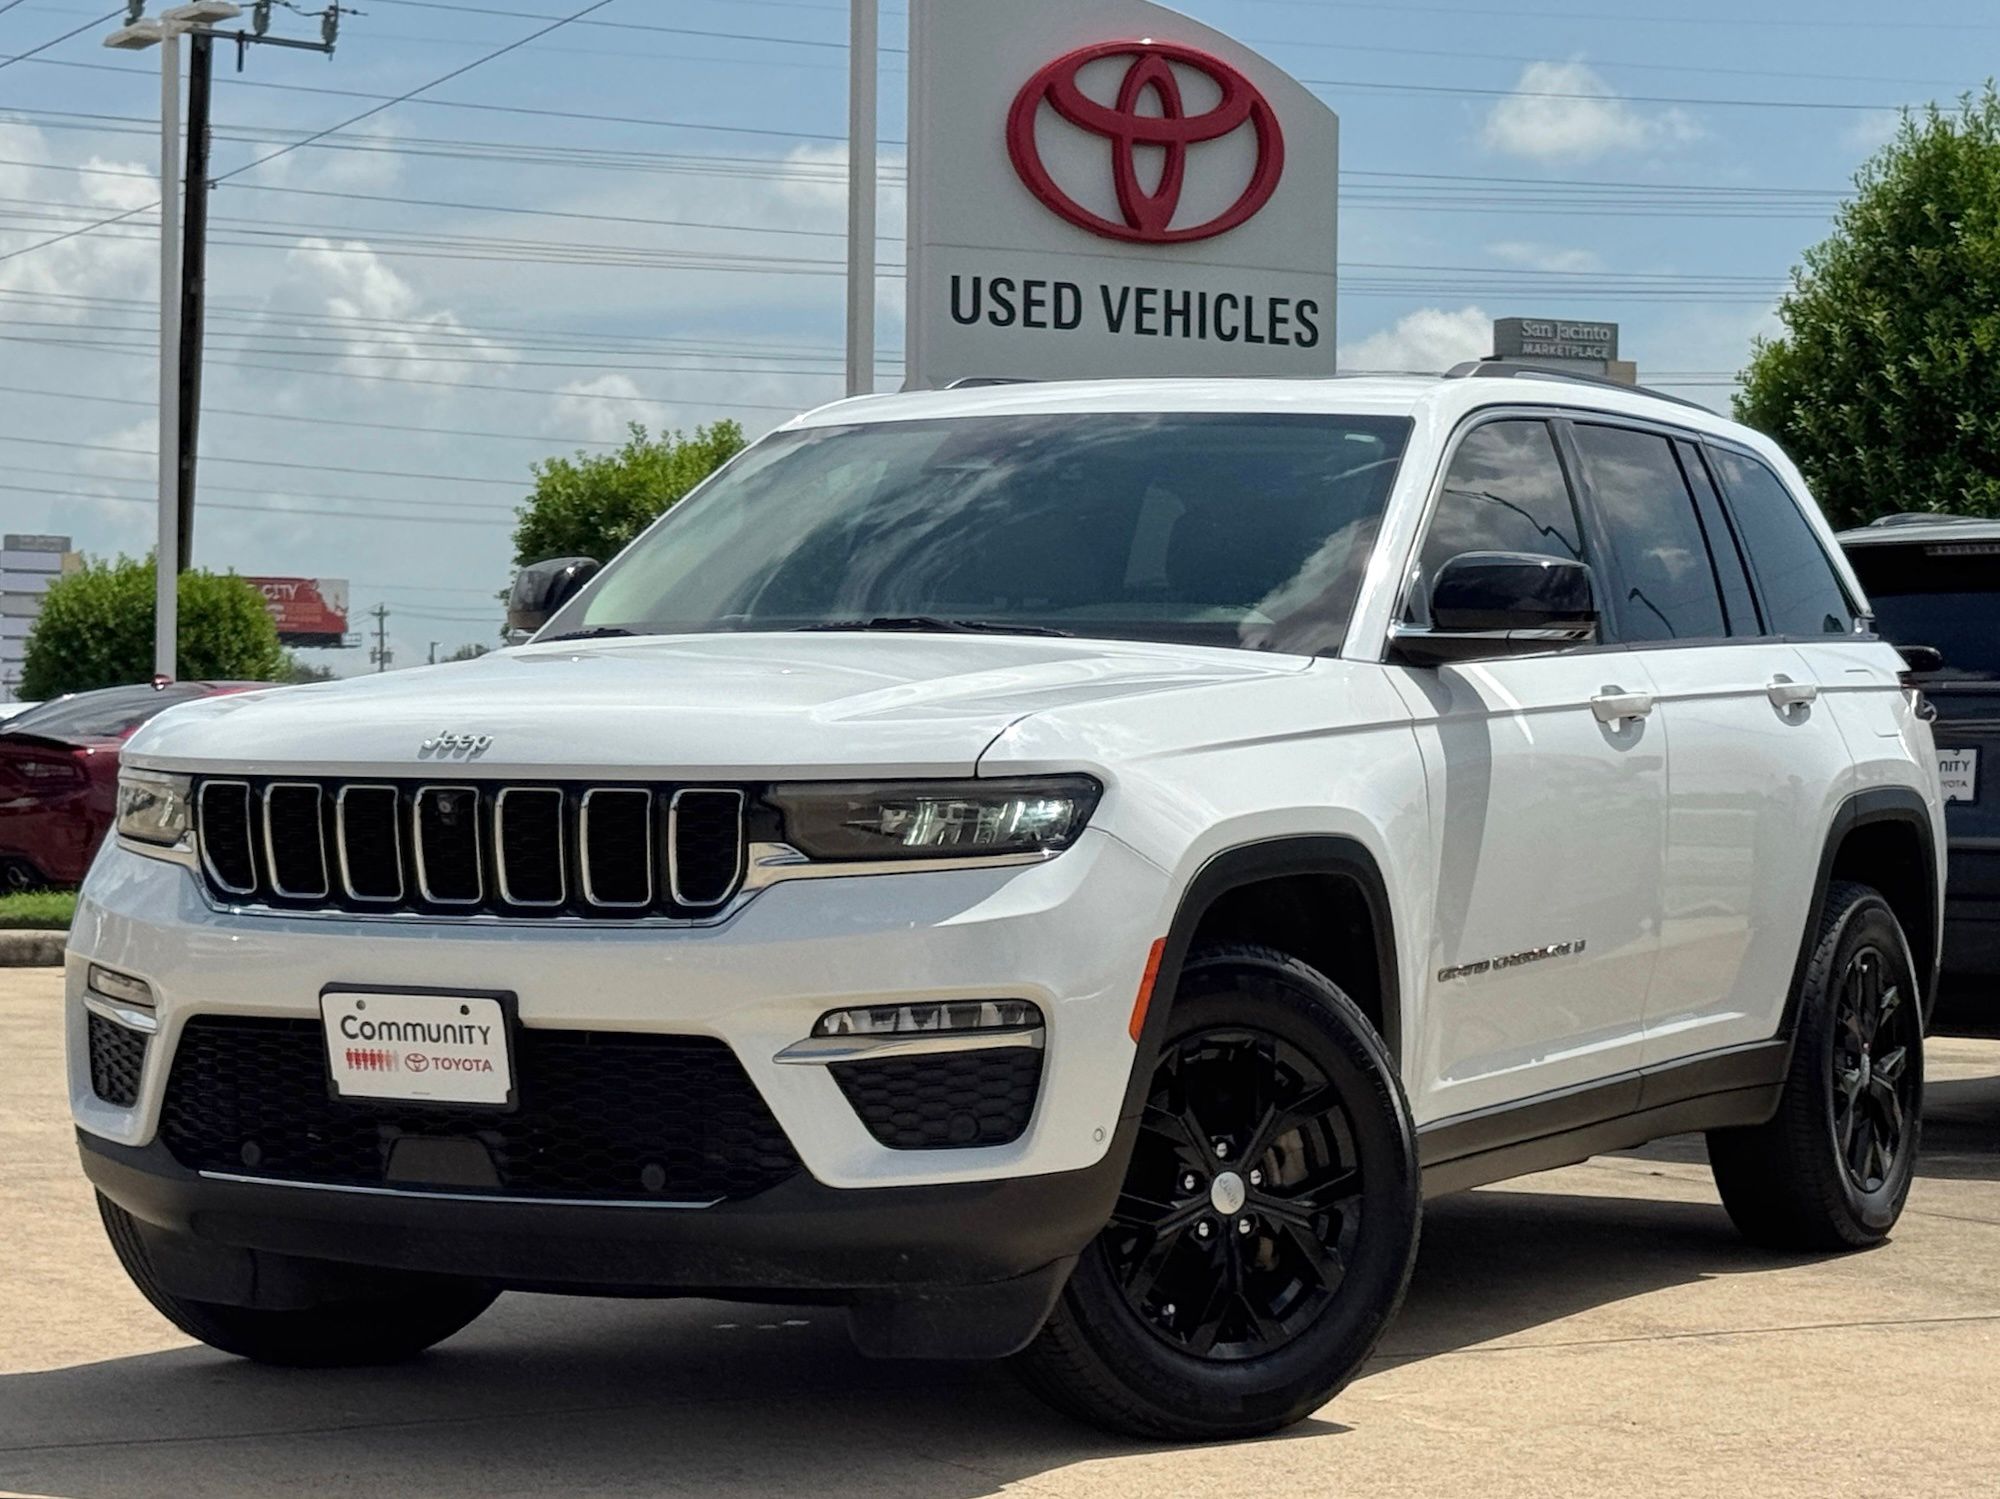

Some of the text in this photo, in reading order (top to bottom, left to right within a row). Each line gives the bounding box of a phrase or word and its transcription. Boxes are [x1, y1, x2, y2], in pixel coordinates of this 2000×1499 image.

[951, 275, 1319, 348] USED VEHICLES
[1522, 319, 1611, 342] San Jacinto
[1522, 343, 1610, 359] MARKETPLACE
[421, 731, 493, 758] Jeep
[432, 1057, 493, 1072] TOYOTA
